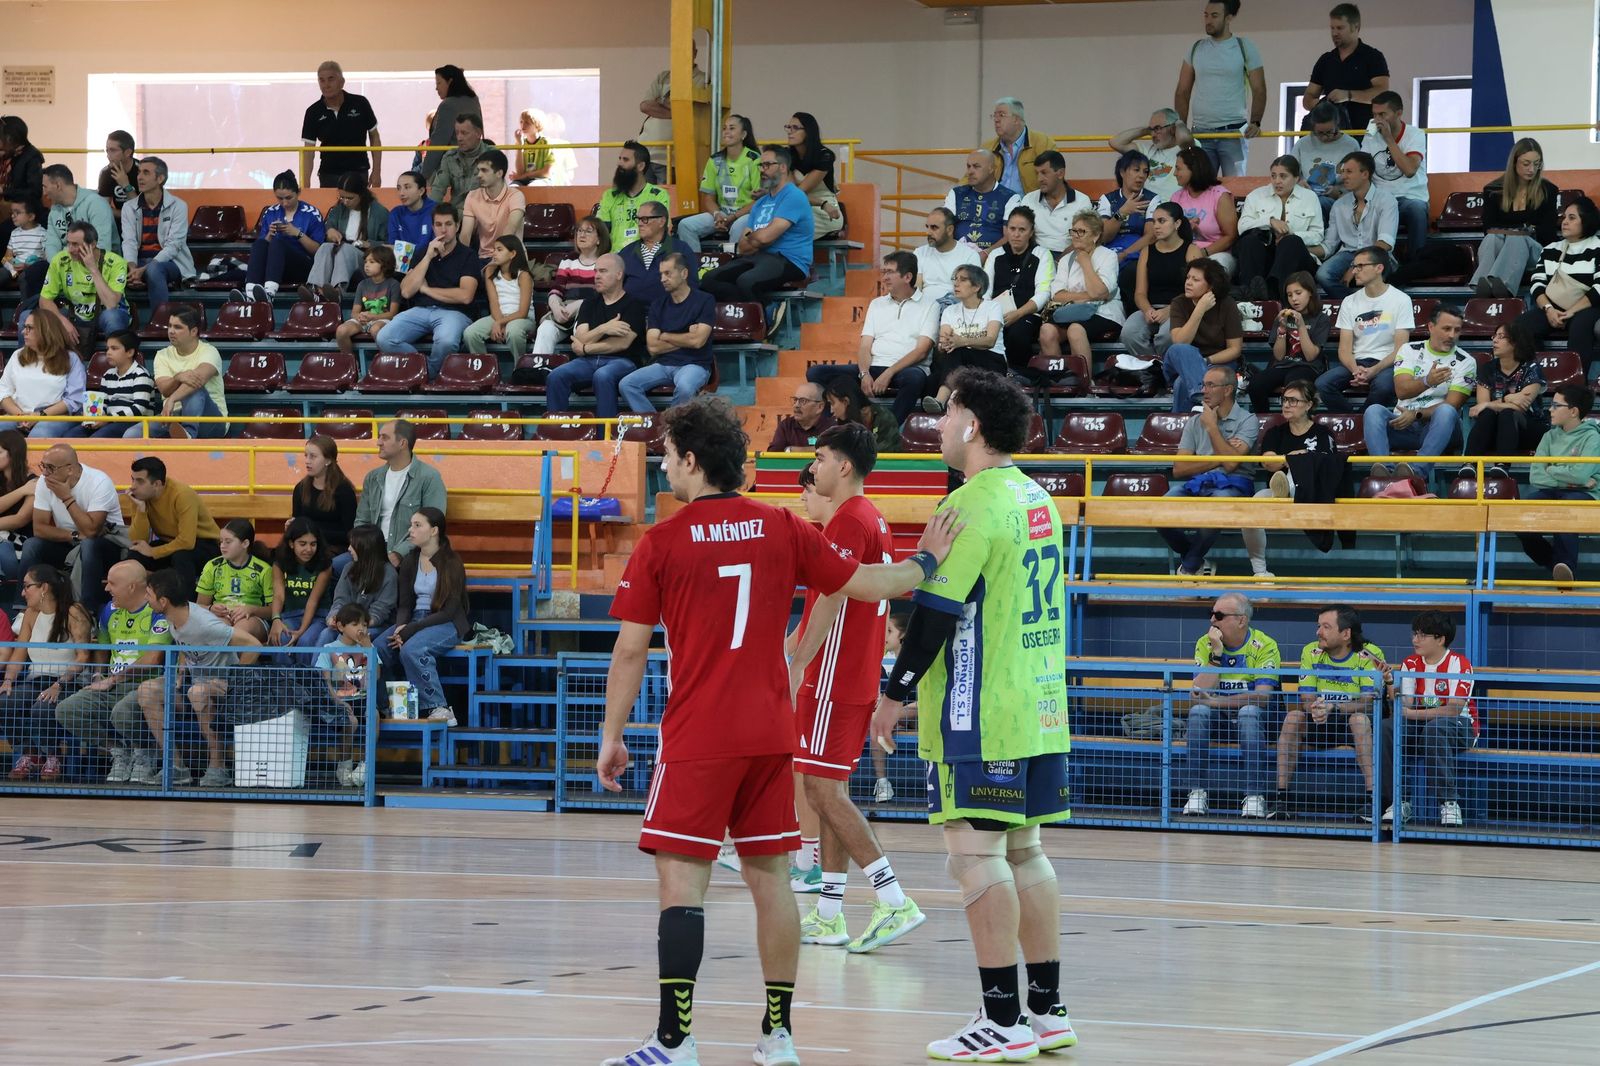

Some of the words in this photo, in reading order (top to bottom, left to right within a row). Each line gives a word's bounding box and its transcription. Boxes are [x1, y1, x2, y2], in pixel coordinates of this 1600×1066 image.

[1466, 196, 1484, 208] 39
[217, 210, 224, 221] 7
[543, 208, 555, 217] 17
[238, 305, 252, 318] 11
[308, 305, 324, 317] 13
[725, 304, 745, 319] 25
[1486, 303, 1503, 317] 41
[250, 355, 268, 369] 13
[467, 357, 482, 371] 19
[1540, 357, 1558, 368] 43
[1084, 417, 1105, 431] 33
[1332, 418, 1355, 431] 39
[1045, 478, 1067, 491] 33
[1129, 478, 1150, 492] 35
[690, 518, 765, 543] M.MÉNDEZ
[231, 577, 241, 593] 8
[718, 563, 752, 650] 7
[1037, 699, 1057, 714] PRO
[971, 786, 1025, 799] UNIVERSAL
